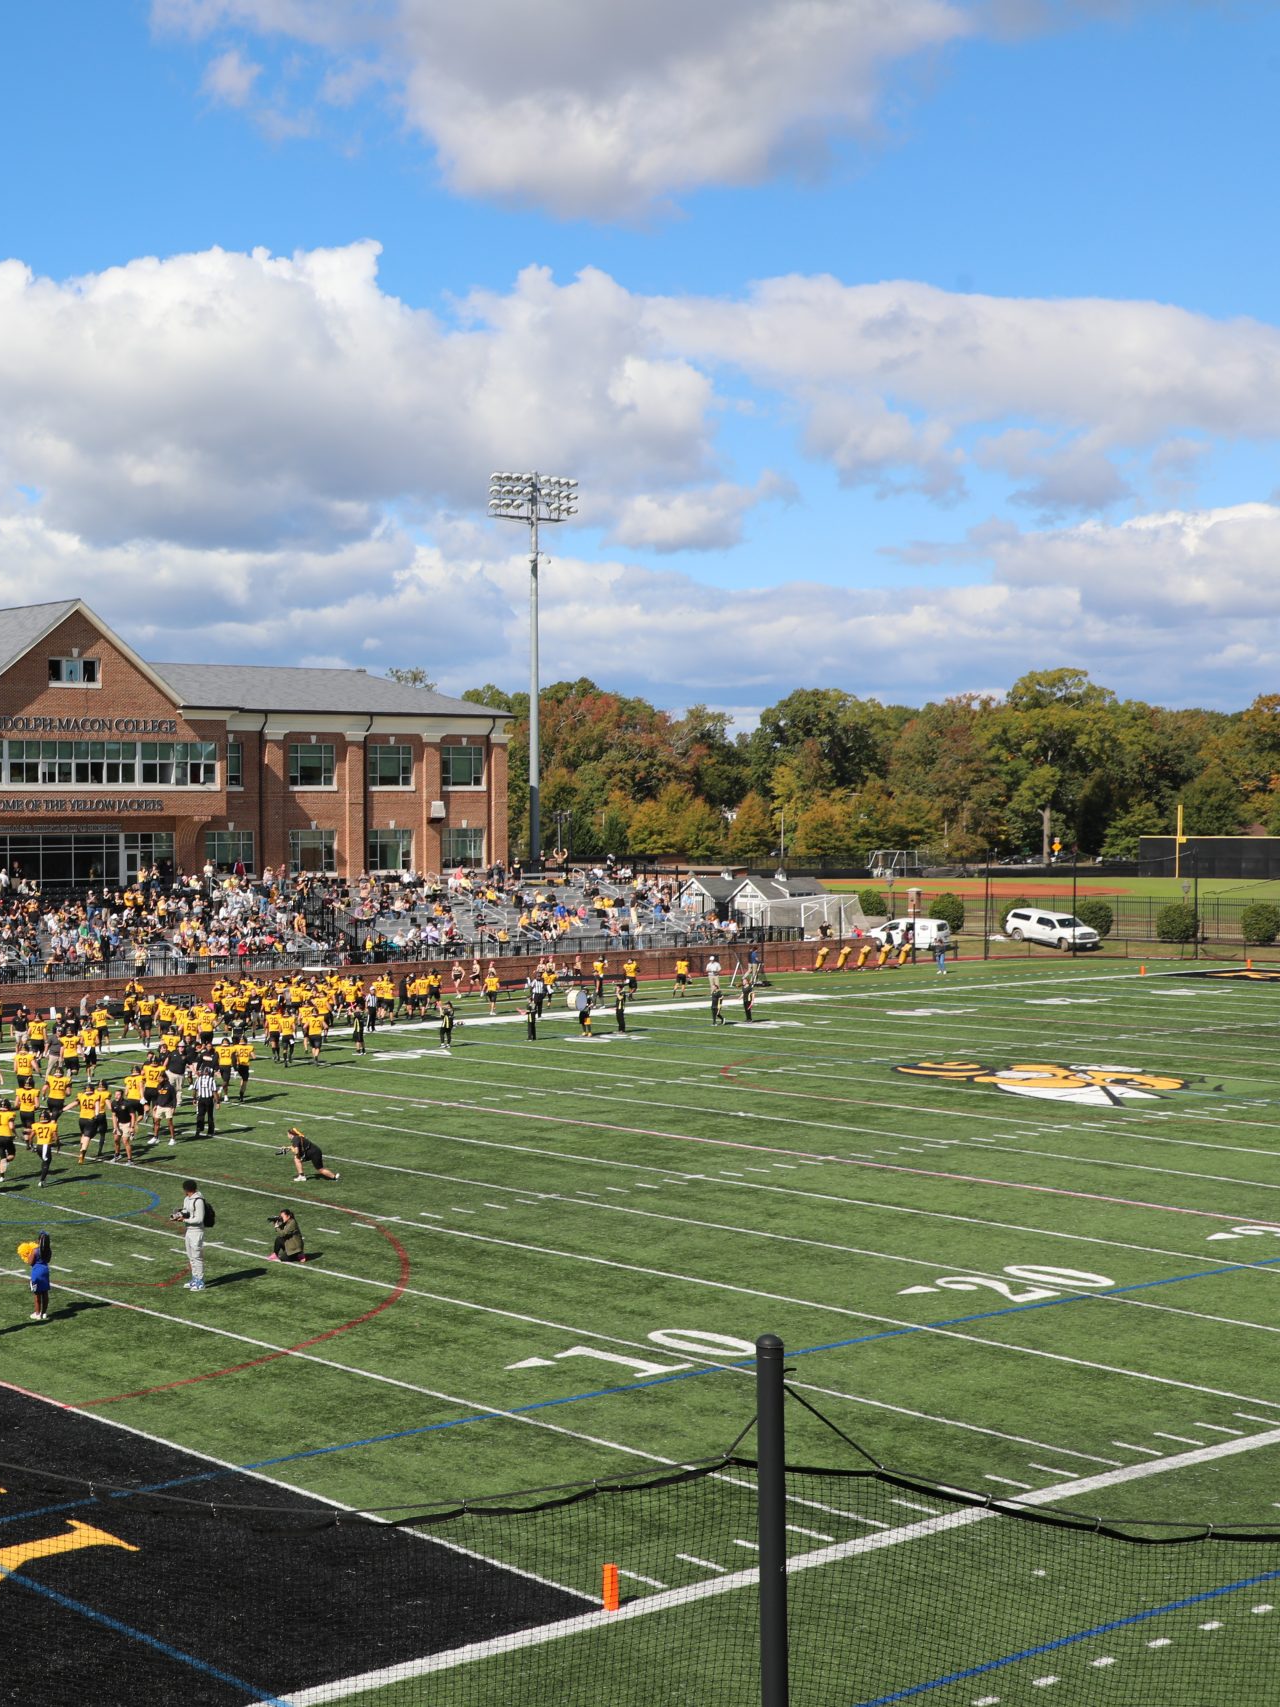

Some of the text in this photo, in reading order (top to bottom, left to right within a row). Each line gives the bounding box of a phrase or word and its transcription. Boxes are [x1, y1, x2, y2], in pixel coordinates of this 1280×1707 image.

[114, 718, 177, 733] COLLEGE
[24, 799, 40, 812] OF
[41, 799, 66, 812] THE
[69, 799, 116, 813] YELLOW
[116, 799, 164, 813] JACKETS
[32, 1025, 42, 1035] 74
[87, 1033, 92, 1041] 2
[65, 1040, 75, 1049] 75
[220, 1048, 230, 1058] 23
[18, 1057, 28, 1068] 69
[148, 1070, 159, 1081] 57
[53, 1080, 64, 1091] 72
[127, 1079, 137, 1090] 34
[21, 1093, 33, 1104] 44
[82, 1098, 94, 1110] 46
[38, 1127, 50, 1139] 27
[934, 1264, 1116, 1303] 20
[553, 1328, 756, 1378] 10
